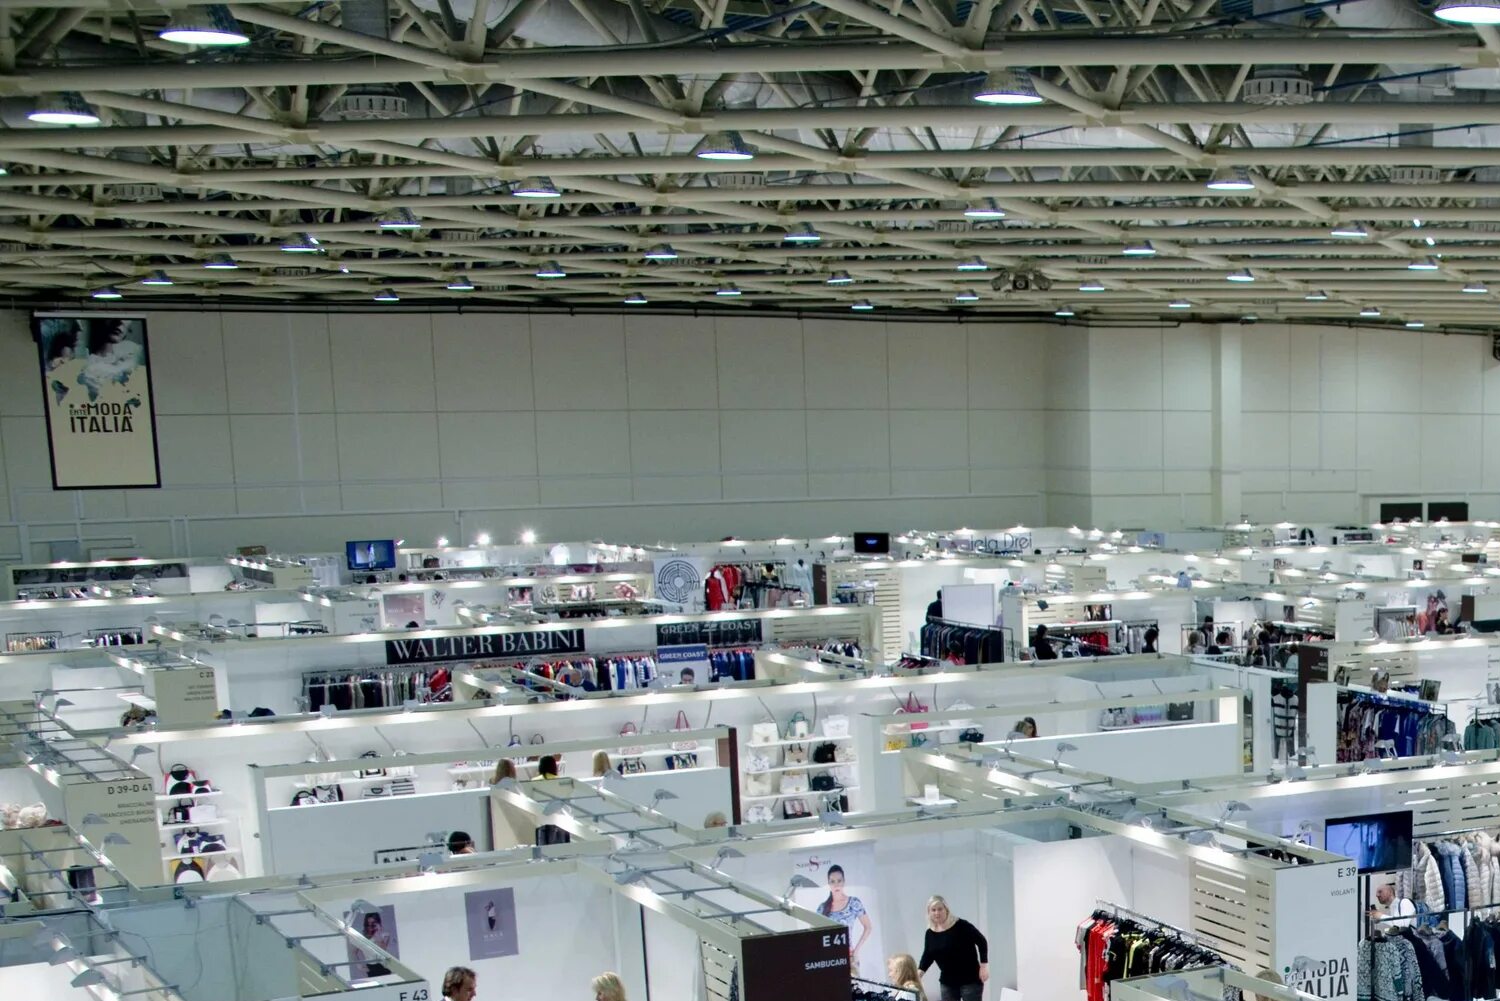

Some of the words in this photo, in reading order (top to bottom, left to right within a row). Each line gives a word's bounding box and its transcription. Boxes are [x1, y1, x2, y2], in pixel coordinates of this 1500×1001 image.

[87, 402, 133, 416] MODA
[70, 416, 133, 433] ITALIA
[1003, 532, 1032, 550] Drei
[660, 623, 699, 635] GREEN
[720, 620, 758, 632] COAST
[392, 634, 493, 660] WALTER
[501, 628, 580, 653] BABINI
[107, 786, 115, 795] D
[142, 783, 153, 792] 41
[1338, 868, 1344, 878] E
[1345, 866, 1357, 877] 39
[1331, 888, 1355, 897] VIOLANTI
[823, 936, 831, 947] E
[833, 933, 847, 945] 41
[804, 958, 847, 970] SAMBUCARI
[412, 989, 429, 1001] 43
